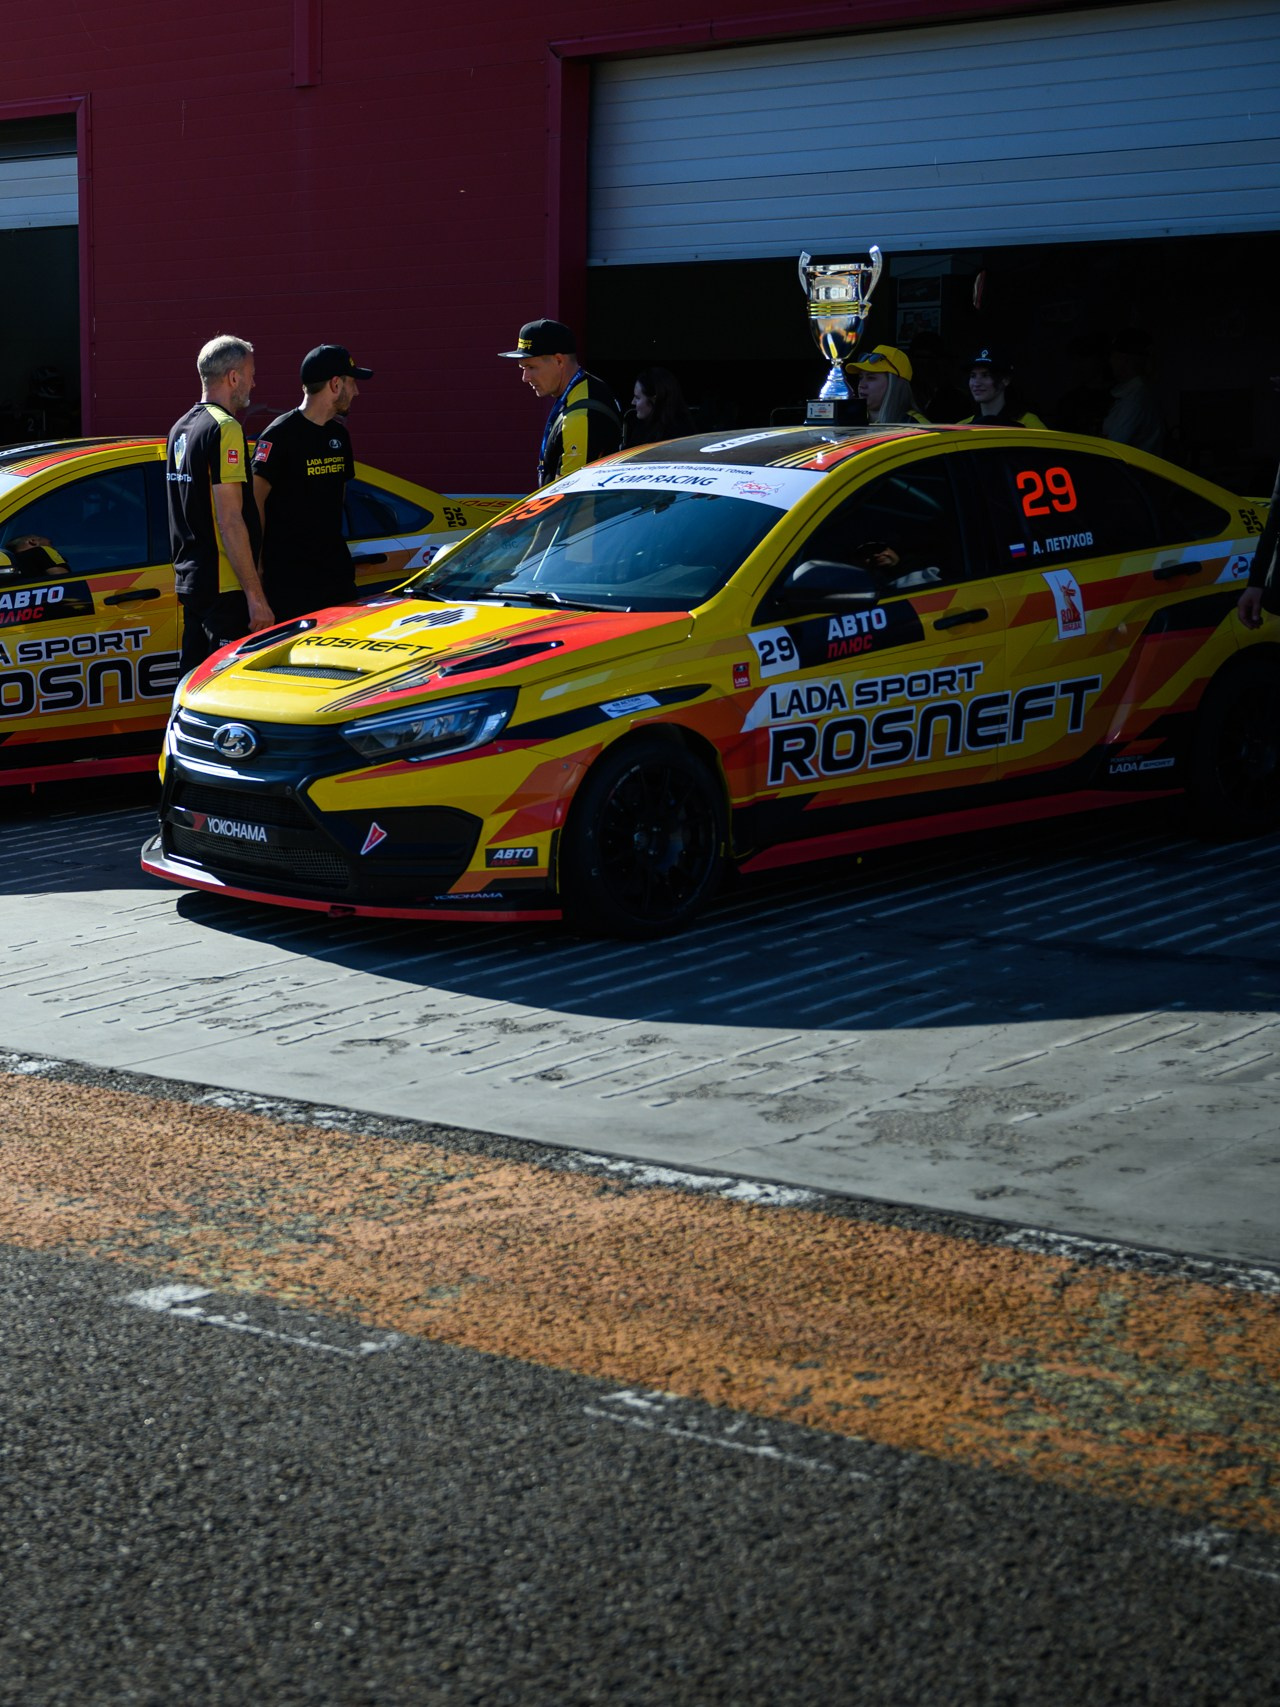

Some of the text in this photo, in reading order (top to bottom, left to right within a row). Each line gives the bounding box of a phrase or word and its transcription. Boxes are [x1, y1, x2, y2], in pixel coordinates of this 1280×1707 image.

[307, 463, 346, 476] ROSNEFT
[324, 456, 345, 465] SPORT
[653, 475, 718, 486] RACING
[1015, 466, 1078, 518] 29
[490, 494, 565, 528] 29
[1032, 531, 1094, 555] А. ПЕТУХОВ
[826, 607, 888, 641] АВТО
[18, 627, 150, 664] SPORT
[297, 636, 432, 656] ROSNEFT
[758, 636, 795, 666] 29
[826, 634, 875, 659] ПЛЮС
[770, 664, 983, 720] LADA SPORT
[768, 674, 1103, 785] ROSNEFT
[1109, 762, 1138, 774] LADA
[207, 817, 268, 843] YOKOHAMA
[493, 848, 534, 859] АВТО
[433, 892, 504, 901] YOKOHAMA
